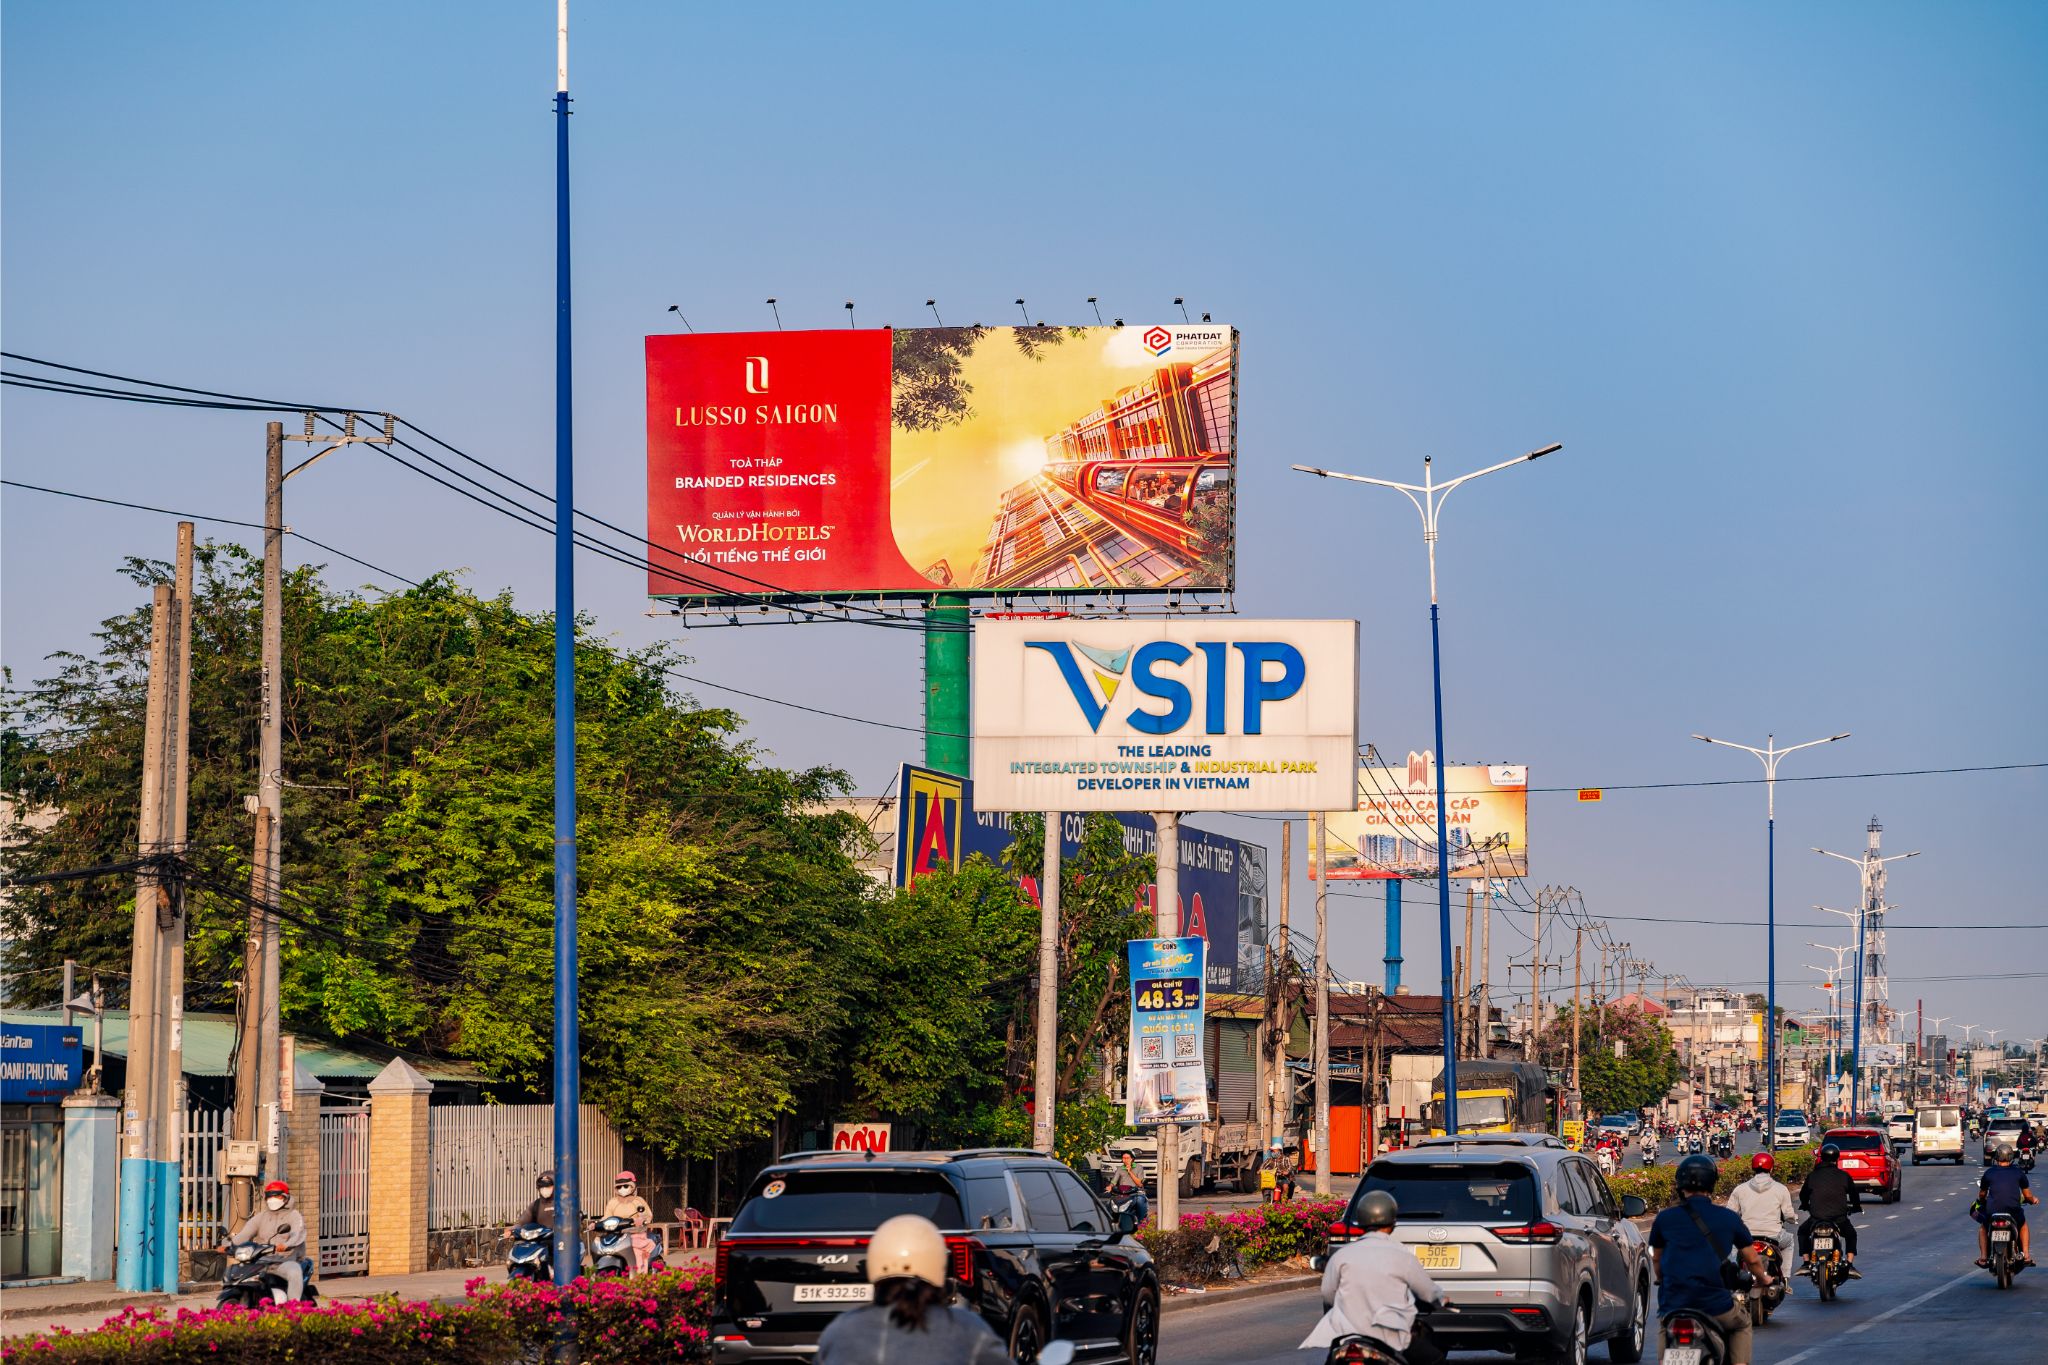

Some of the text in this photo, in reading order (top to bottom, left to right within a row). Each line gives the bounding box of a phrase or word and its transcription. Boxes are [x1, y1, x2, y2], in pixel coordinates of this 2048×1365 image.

[676, 404, 837, 426] LUSSO SAIGON
[730, 457, 783, 469] TOÀ THÁP
[675, 474, 837, 488] BRANDED RESIDENCES
[763, 510, 785, 518] HÀNH
[714, 547, 759, 563] TIẾNG
[762, 546, 790, 562] THẾ
[794, 546, 826, 561] GIỚI
[1024, 640, 1306, 735] VSIP
[1118, 745, 1211, 758] THE LEADING
[1010, 761, 1317, 774] INTEGRATED TOWNSHIP & INDUSTRIAL PARK
[1077, 777, 1250, 790] DEVELOPER IN VIETNAM
[1450, 796, 1480, 810] CẤP
[1366, 812, 1389, 826] GIÁ
[1394, 811, 1437, 827] QUỐC
[1214, 843, 1234, 874] THÉP
[1138, 989, 1183, 1009] 48.3
[0, 1058, 69, 1085] OANH PHỤ TÙNG
[1427, 1246, 1447, 1257] 50E
[816, 1254, 849, 1264] KIA
